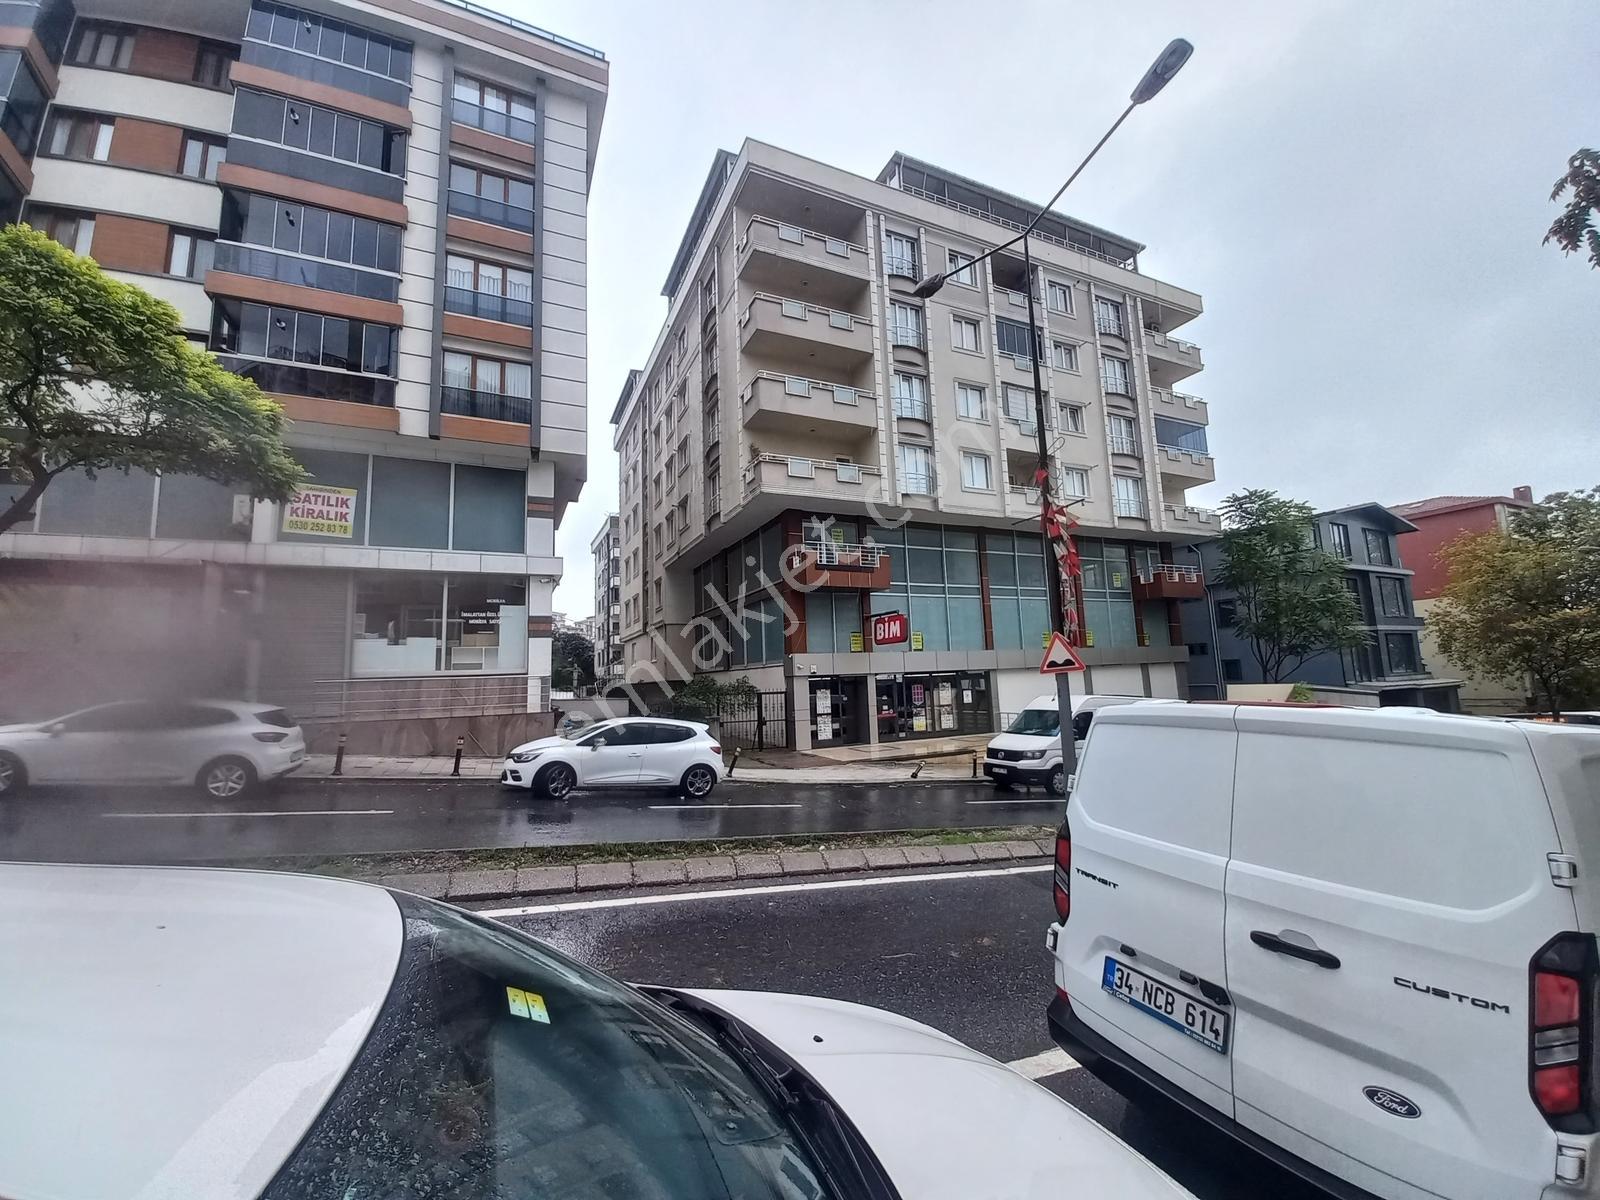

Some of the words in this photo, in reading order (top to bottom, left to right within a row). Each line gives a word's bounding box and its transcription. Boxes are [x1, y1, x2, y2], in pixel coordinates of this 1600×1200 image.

[292, 492, 351, 509] SATILIK
[289, 505, 351, 523] KİRALIK
[310, 522, 325, 533] 252
[338, 525, 349, 535] 78
[876, 617, 901, 641] BİM
[1075, 867, 1119, 889] TRANSIT
[1114, 967, 1134, 995] 34
[1142, 980, 1176, 1016] NCB
[1184, 1002, 1220, 1042] 614
[1393, 976, 1510, 1014] CUSTOM
[1373, 1092, 1408, 1114] Ford
